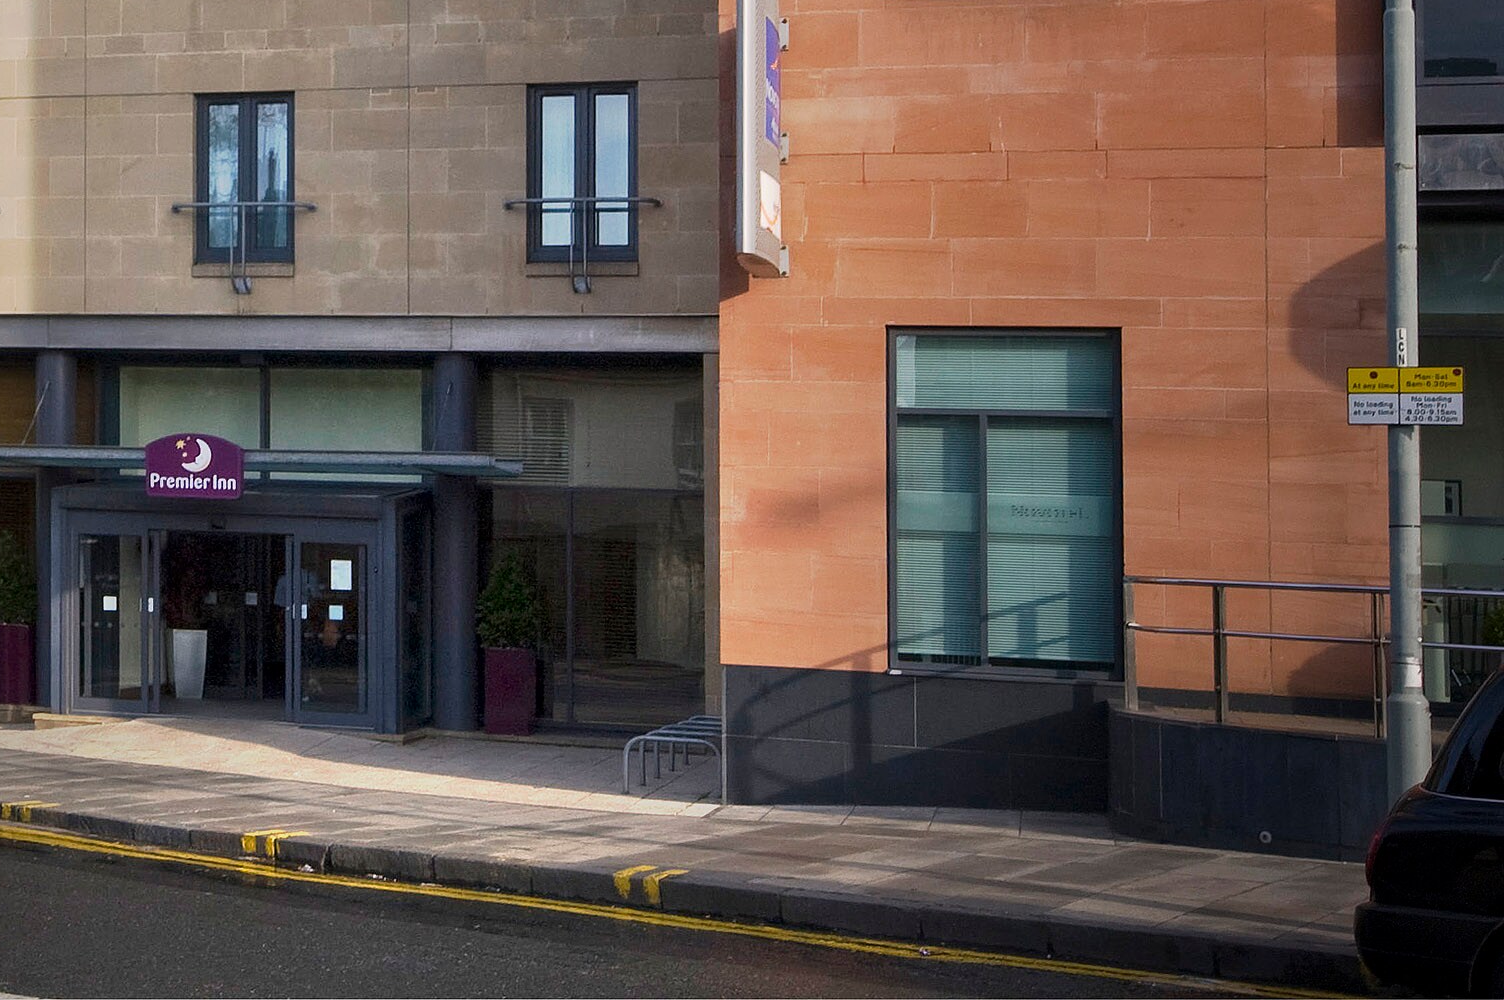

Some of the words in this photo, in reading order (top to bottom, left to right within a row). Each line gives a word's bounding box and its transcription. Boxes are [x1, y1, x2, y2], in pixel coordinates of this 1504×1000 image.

[1363, 383, 1376, 391] any
[1424, 395, 1452, 404] loading
[1366, 401, 1394, 410] loading
[150, 472, 210, 490] Premier
[212, 474, 236, 491] Inn
